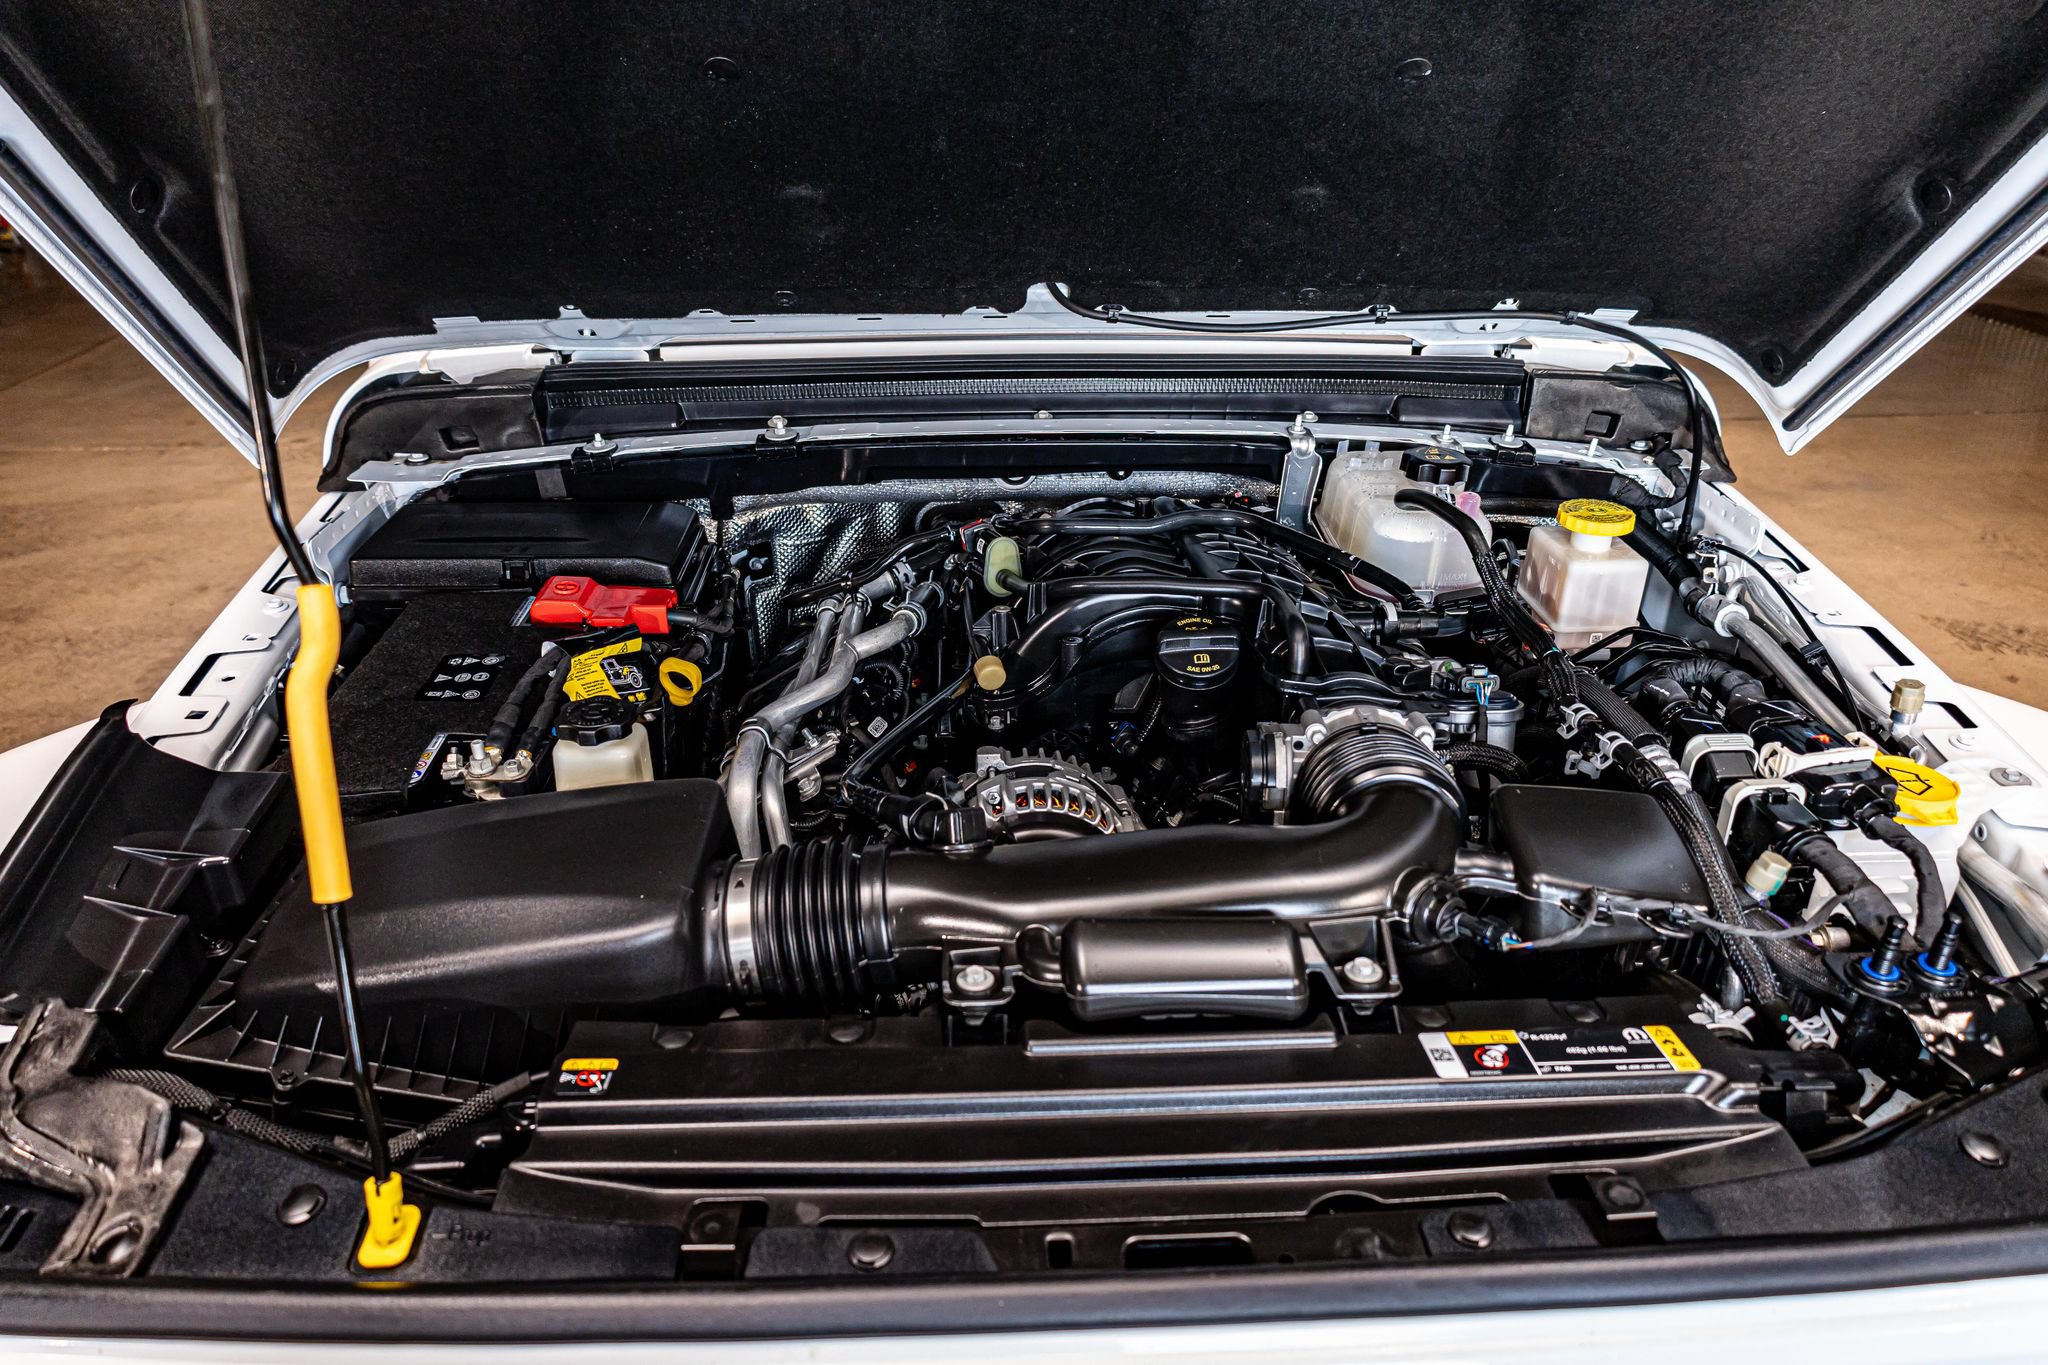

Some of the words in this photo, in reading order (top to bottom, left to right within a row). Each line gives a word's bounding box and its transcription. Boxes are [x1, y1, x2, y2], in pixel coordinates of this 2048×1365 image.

[1177, 617, 1201, 626] ENGINE
[1187, 665, 1200, 673] SAE
[1201, 664, 1220, 673] 0W-20
